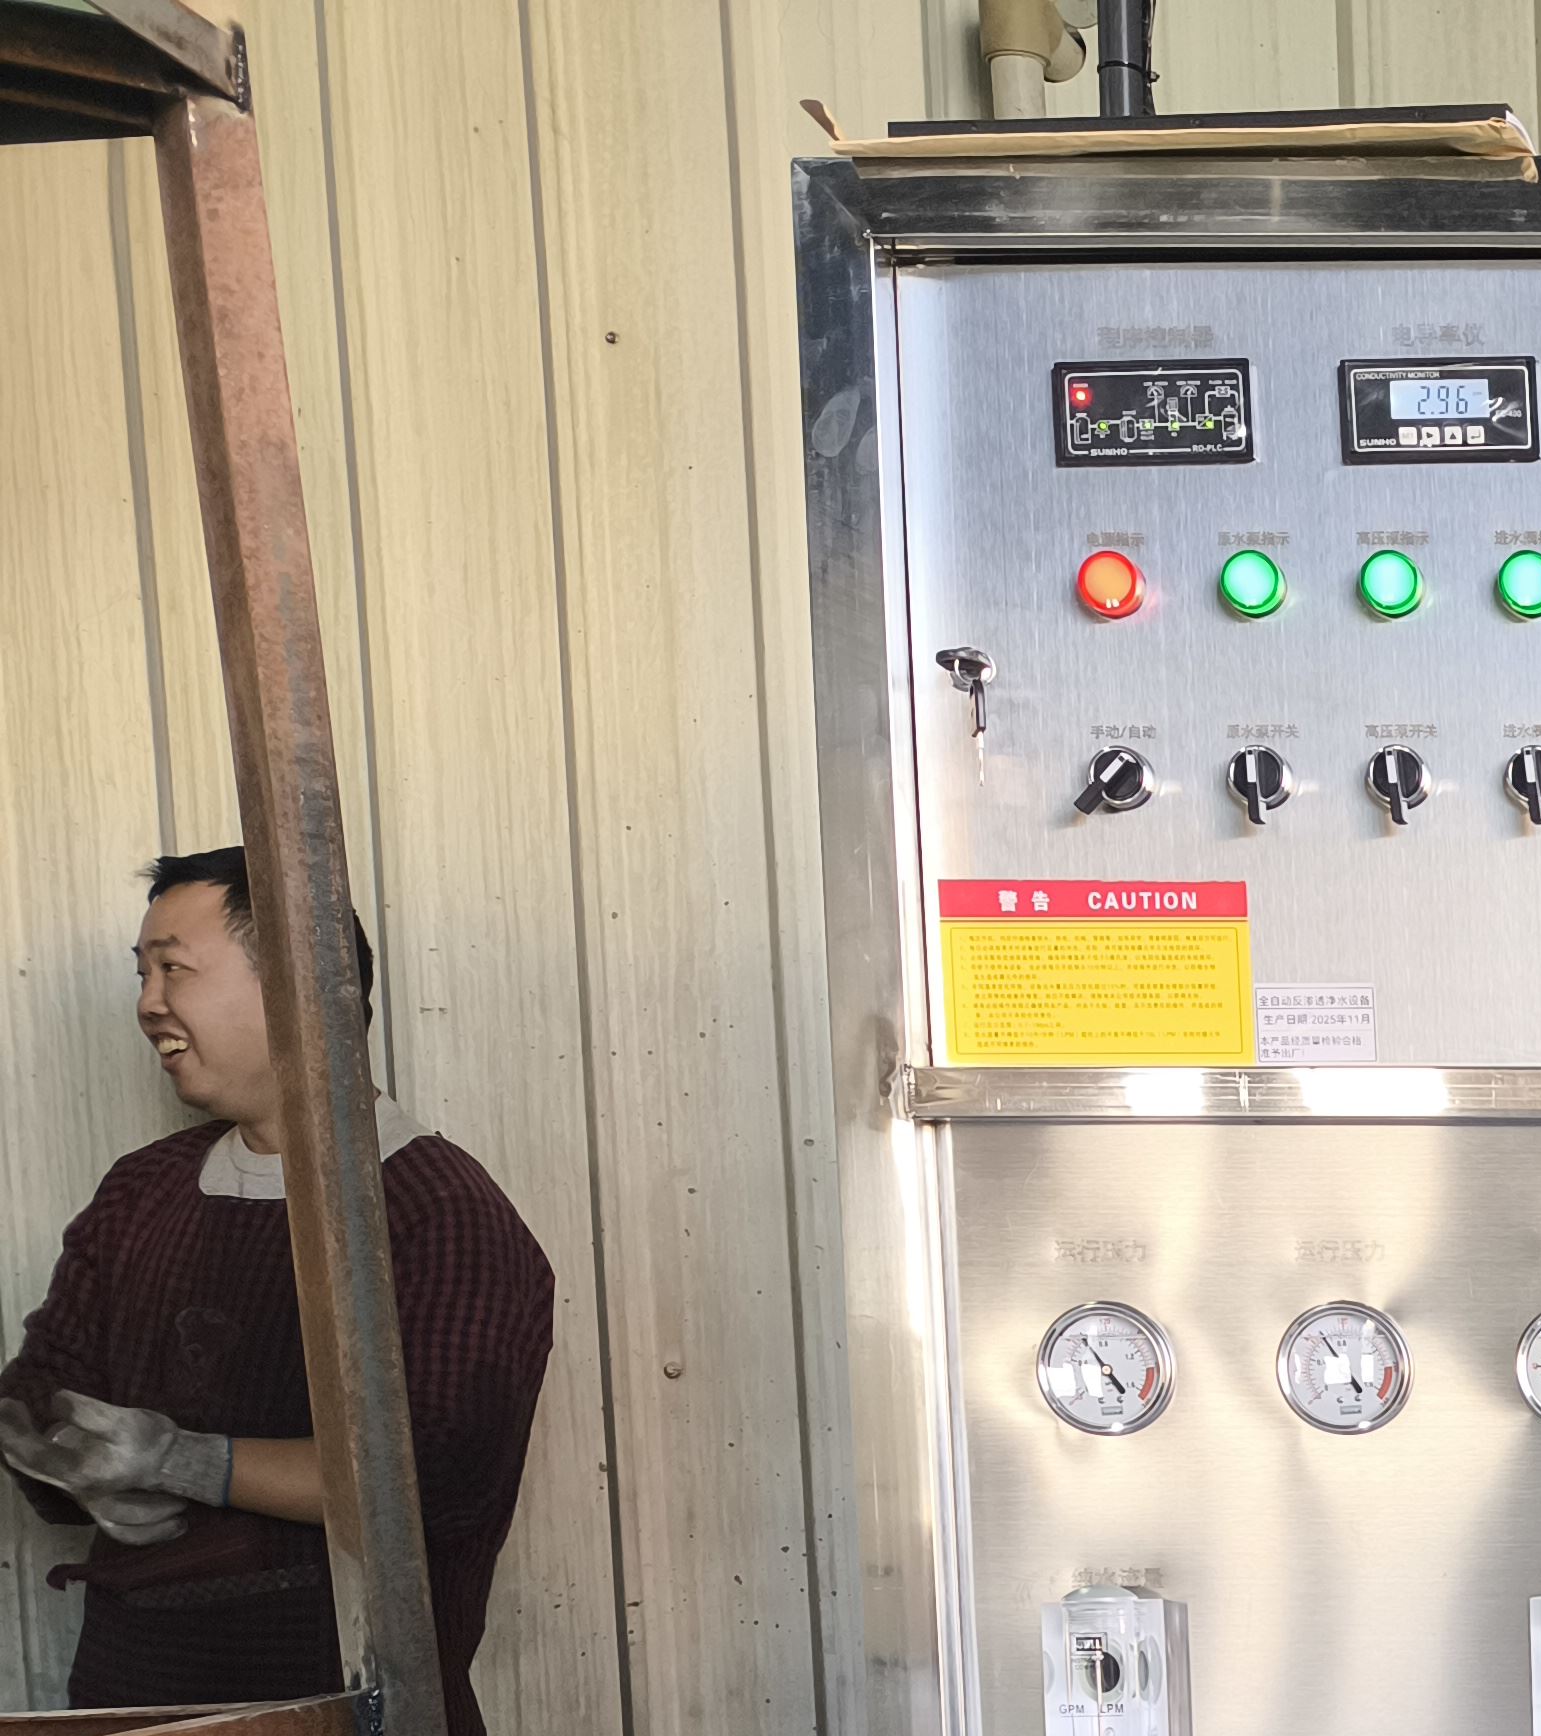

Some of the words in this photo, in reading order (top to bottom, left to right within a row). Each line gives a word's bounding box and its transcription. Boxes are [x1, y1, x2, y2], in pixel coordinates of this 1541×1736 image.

[1417, 385, 1468, 415] 2.96
[1090, 724, 1157, 739] 手动/自动
[1087, 890, 1198, 911] CAUTION
[1059, 1704, 1085, 1714] GPM
[1100, 1703, 1124, 1714] LPM
